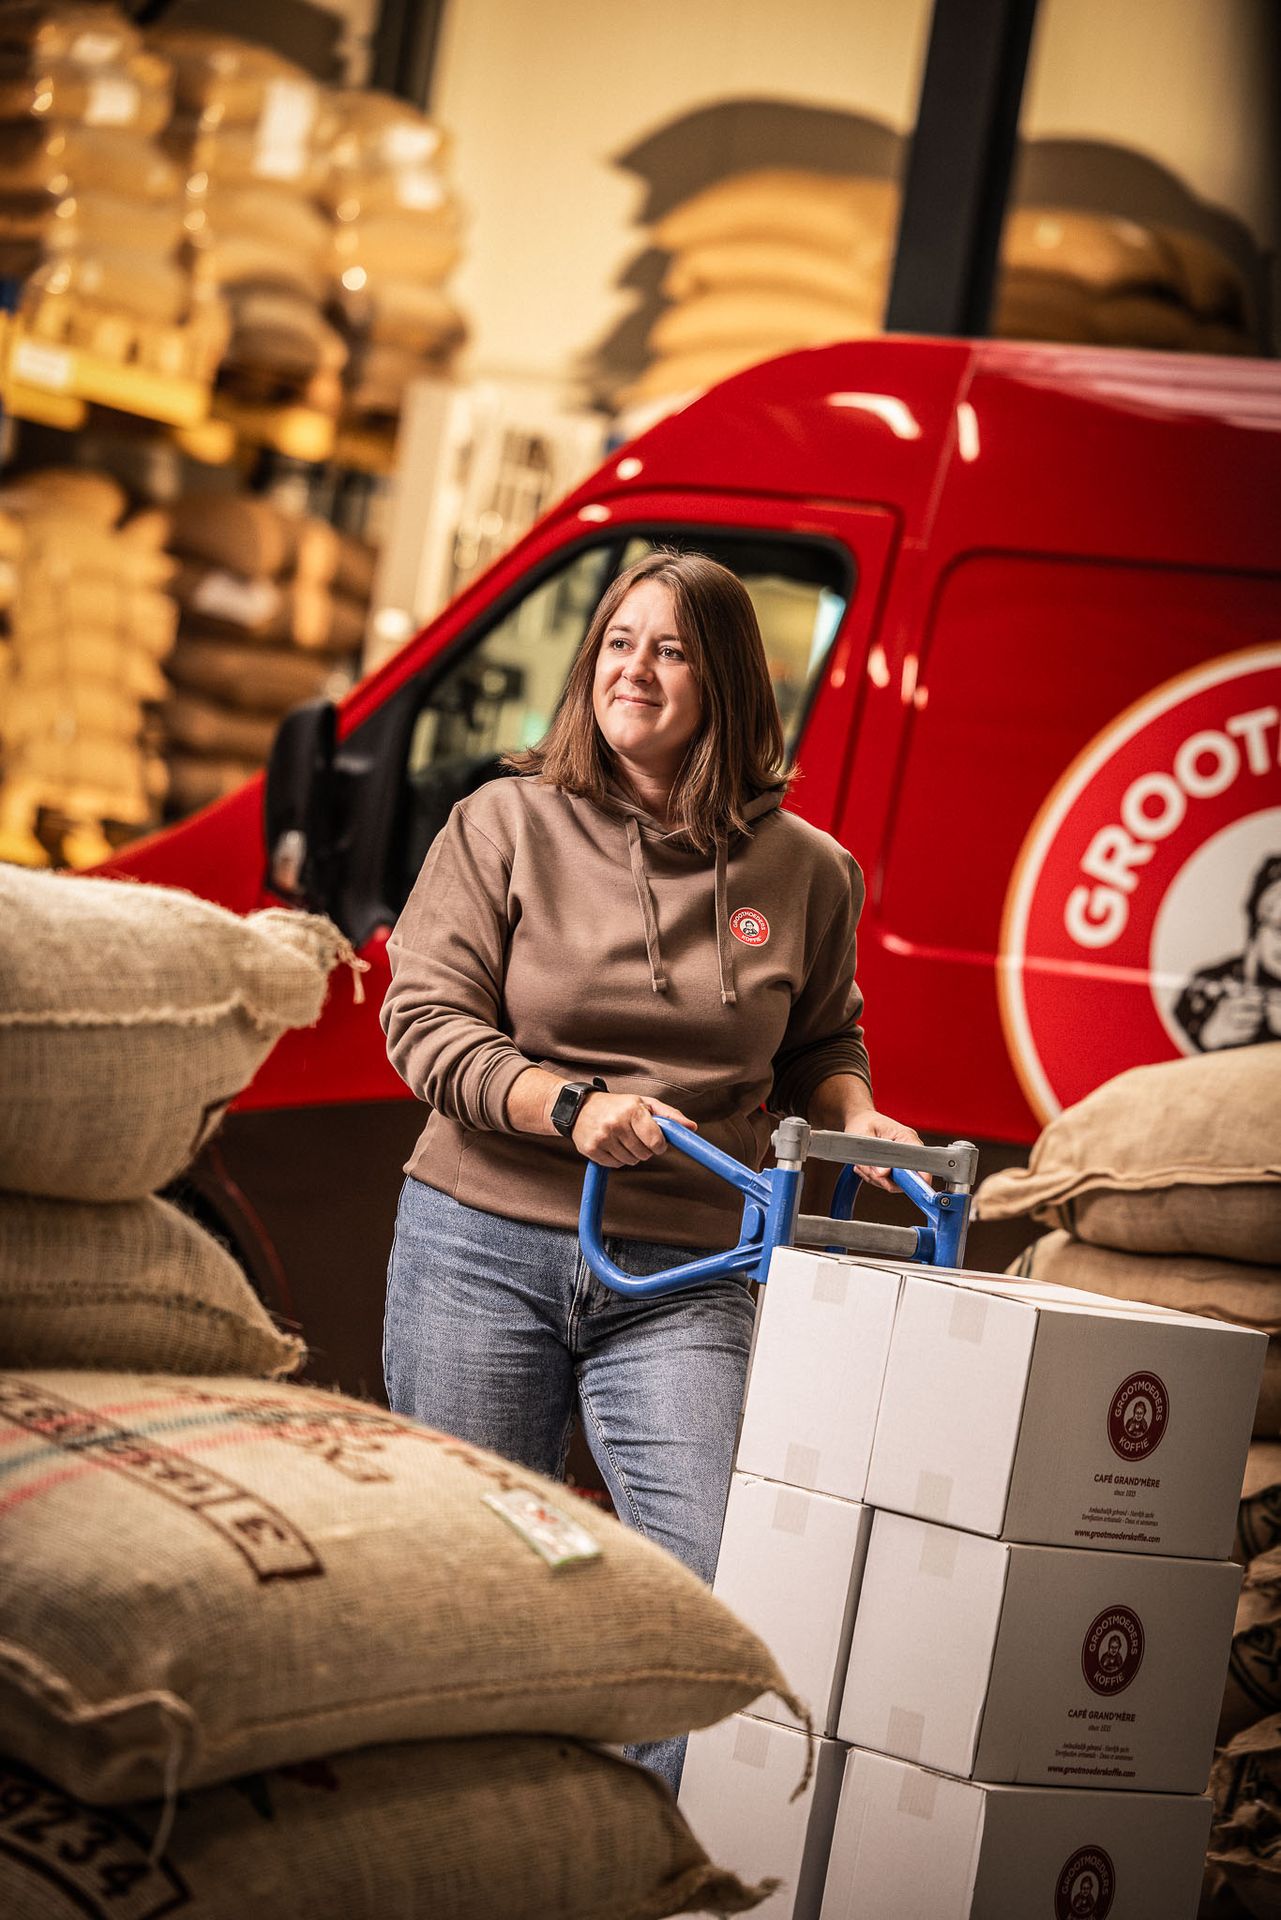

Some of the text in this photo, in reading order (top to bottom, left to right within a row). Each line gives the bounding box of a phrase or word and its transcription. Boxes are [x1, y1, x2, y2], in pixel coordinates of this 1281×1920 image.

[1064, 705, 1281, 949] GROOT
[1115, 1381, 1163, 1422] GROOTMOEDERS
[1118, 1436, 1150, 1452] KOFFIE
[1094, 1473, 1113, 1484] CAFÉ
[1074, 1529, 1161, 1543] www.grootmoederskoffie.com
[1089, 1615, 1138, 1656] GROOTMOEDERS
[1093, 1669, 1125, 1687] KOFFIE
[1068, 1708, 1087, 1719] CAFÉ
[1061, 1855, 1110, 1896] GROOTMOEDERS
